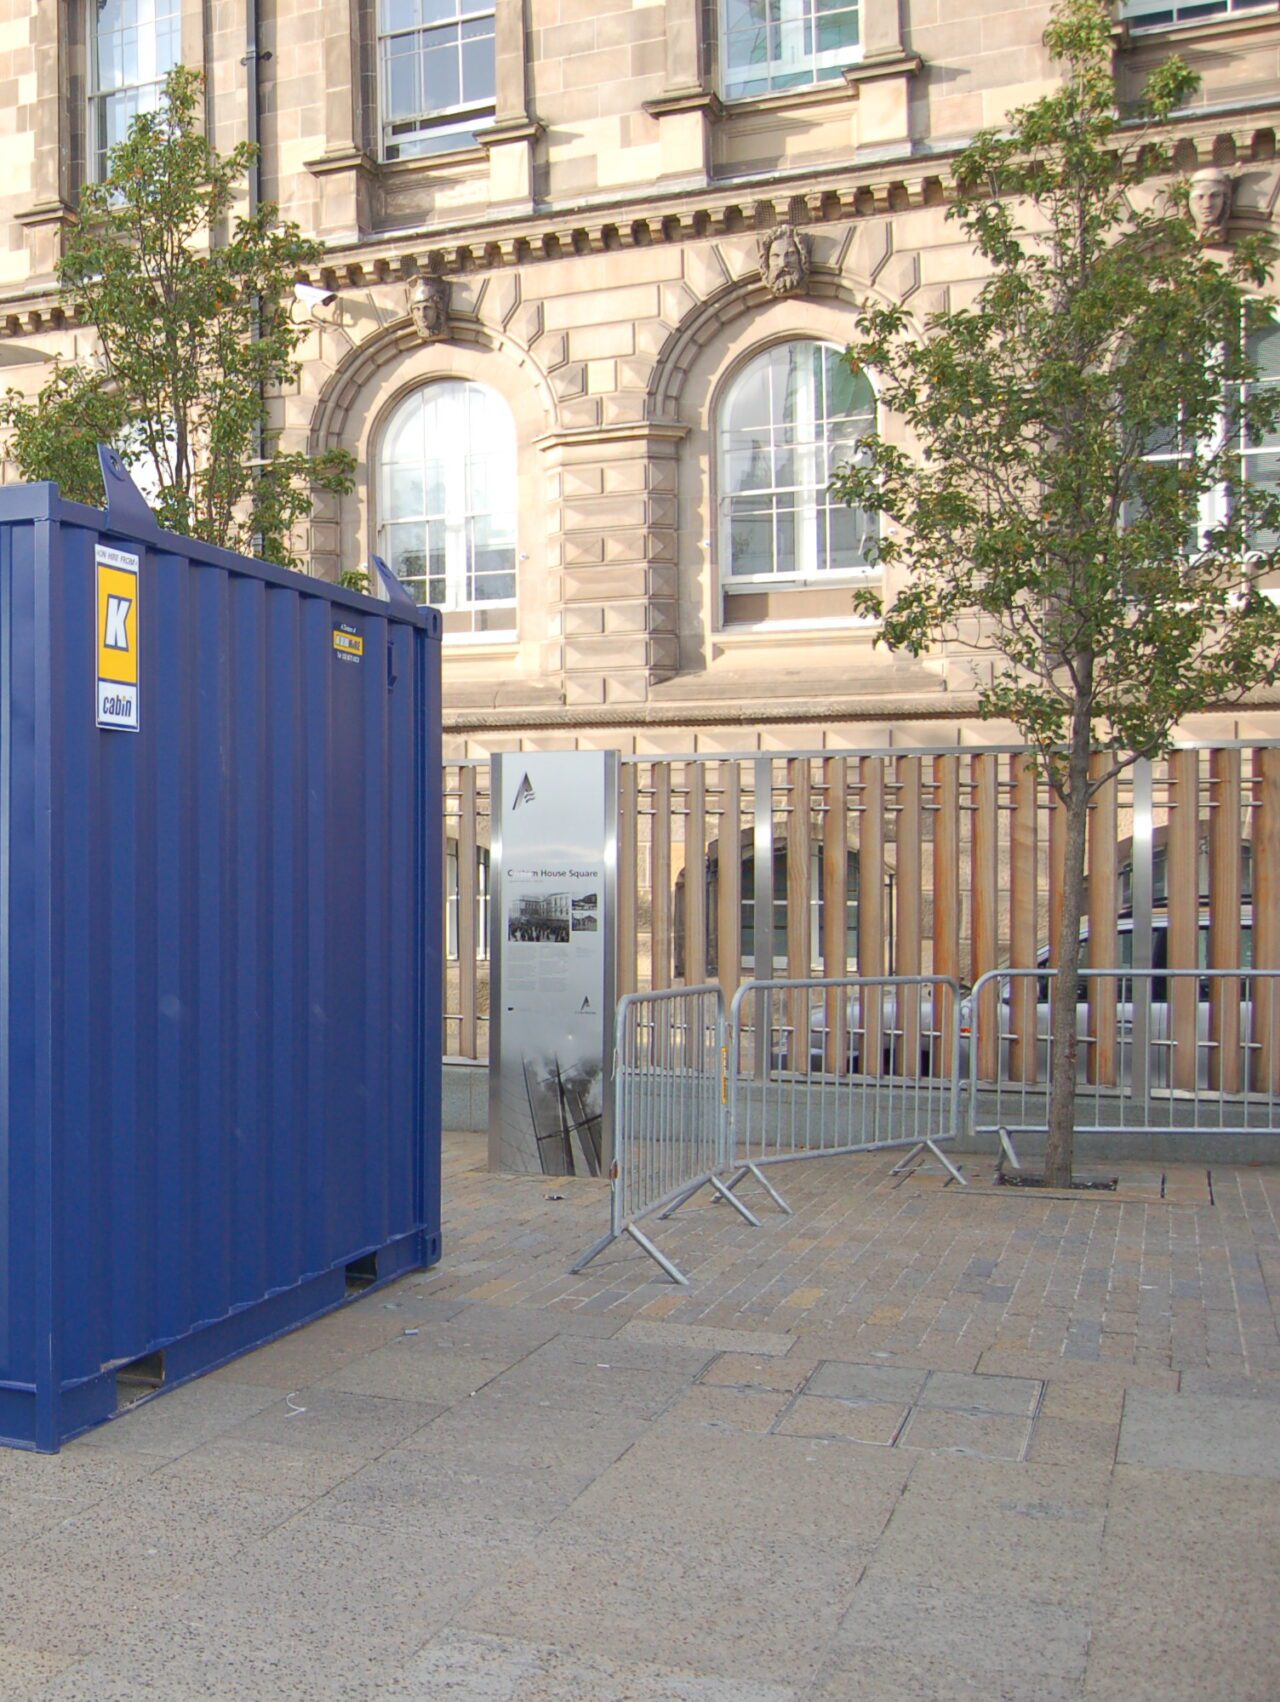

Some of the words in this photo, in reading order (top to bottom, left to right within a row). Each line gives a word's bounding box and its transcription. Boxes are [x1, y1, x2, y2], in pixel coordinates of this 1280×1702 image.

[104, 594, 133, 652] K
[102, 694, 132, 717] cabin
[540, 869, 566, 877] House
[569, 869, 598, 878] Square
